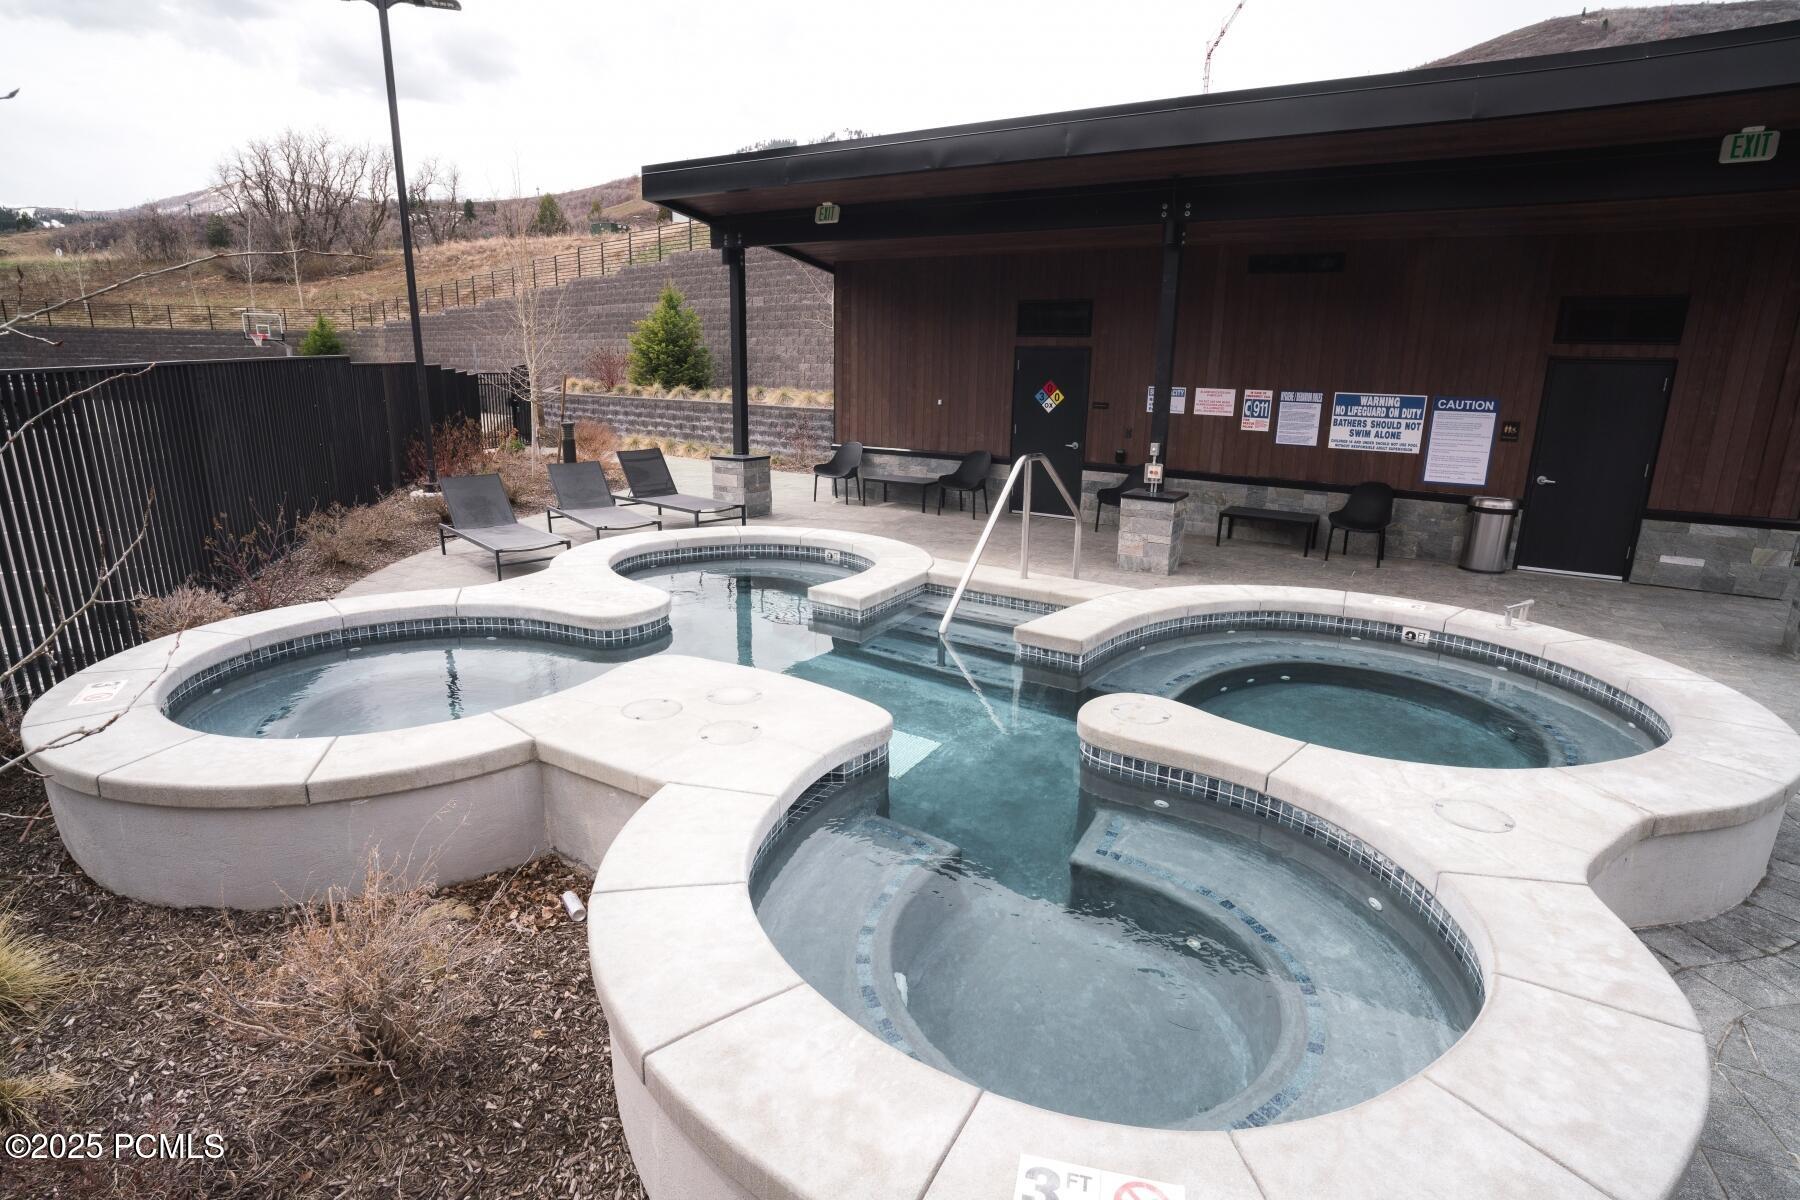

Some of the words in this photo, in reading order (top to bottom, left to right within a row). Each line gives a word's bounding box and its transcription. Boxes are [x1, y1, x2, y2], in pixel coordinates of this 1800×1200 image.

[1730, 132, 1774, 159] EXIT
[819, 206, 836, 221] EXIT
[1039, 392, 1045, 401] 3
[1054, 392, 1060, 402] 0
[1360, 395, 1401, 407] WARNING
[1253, 401, 1269, 417] 911
[1438, 399, 1494, 411] CAUTION
[1335, 405, 1345, 415] NO
[1347, 405, 1386, 417] LIFEGUARD
[1389, 407, 1400, 418] ON
[1401, 408, 1422, 419] DUTY
[1333, 418, 1367, 428] BATHERS
[1370, 420, 1402, 430] SHOULD
[1404, 421, 1421, 431] NOT
[1349, 429, 1371, 438] SWIM
[1373, 430, 1402, 440] ALONE
[1021, 1166, 1061, 1200] 3
[1066, 1172, 1093, 1193] FT
